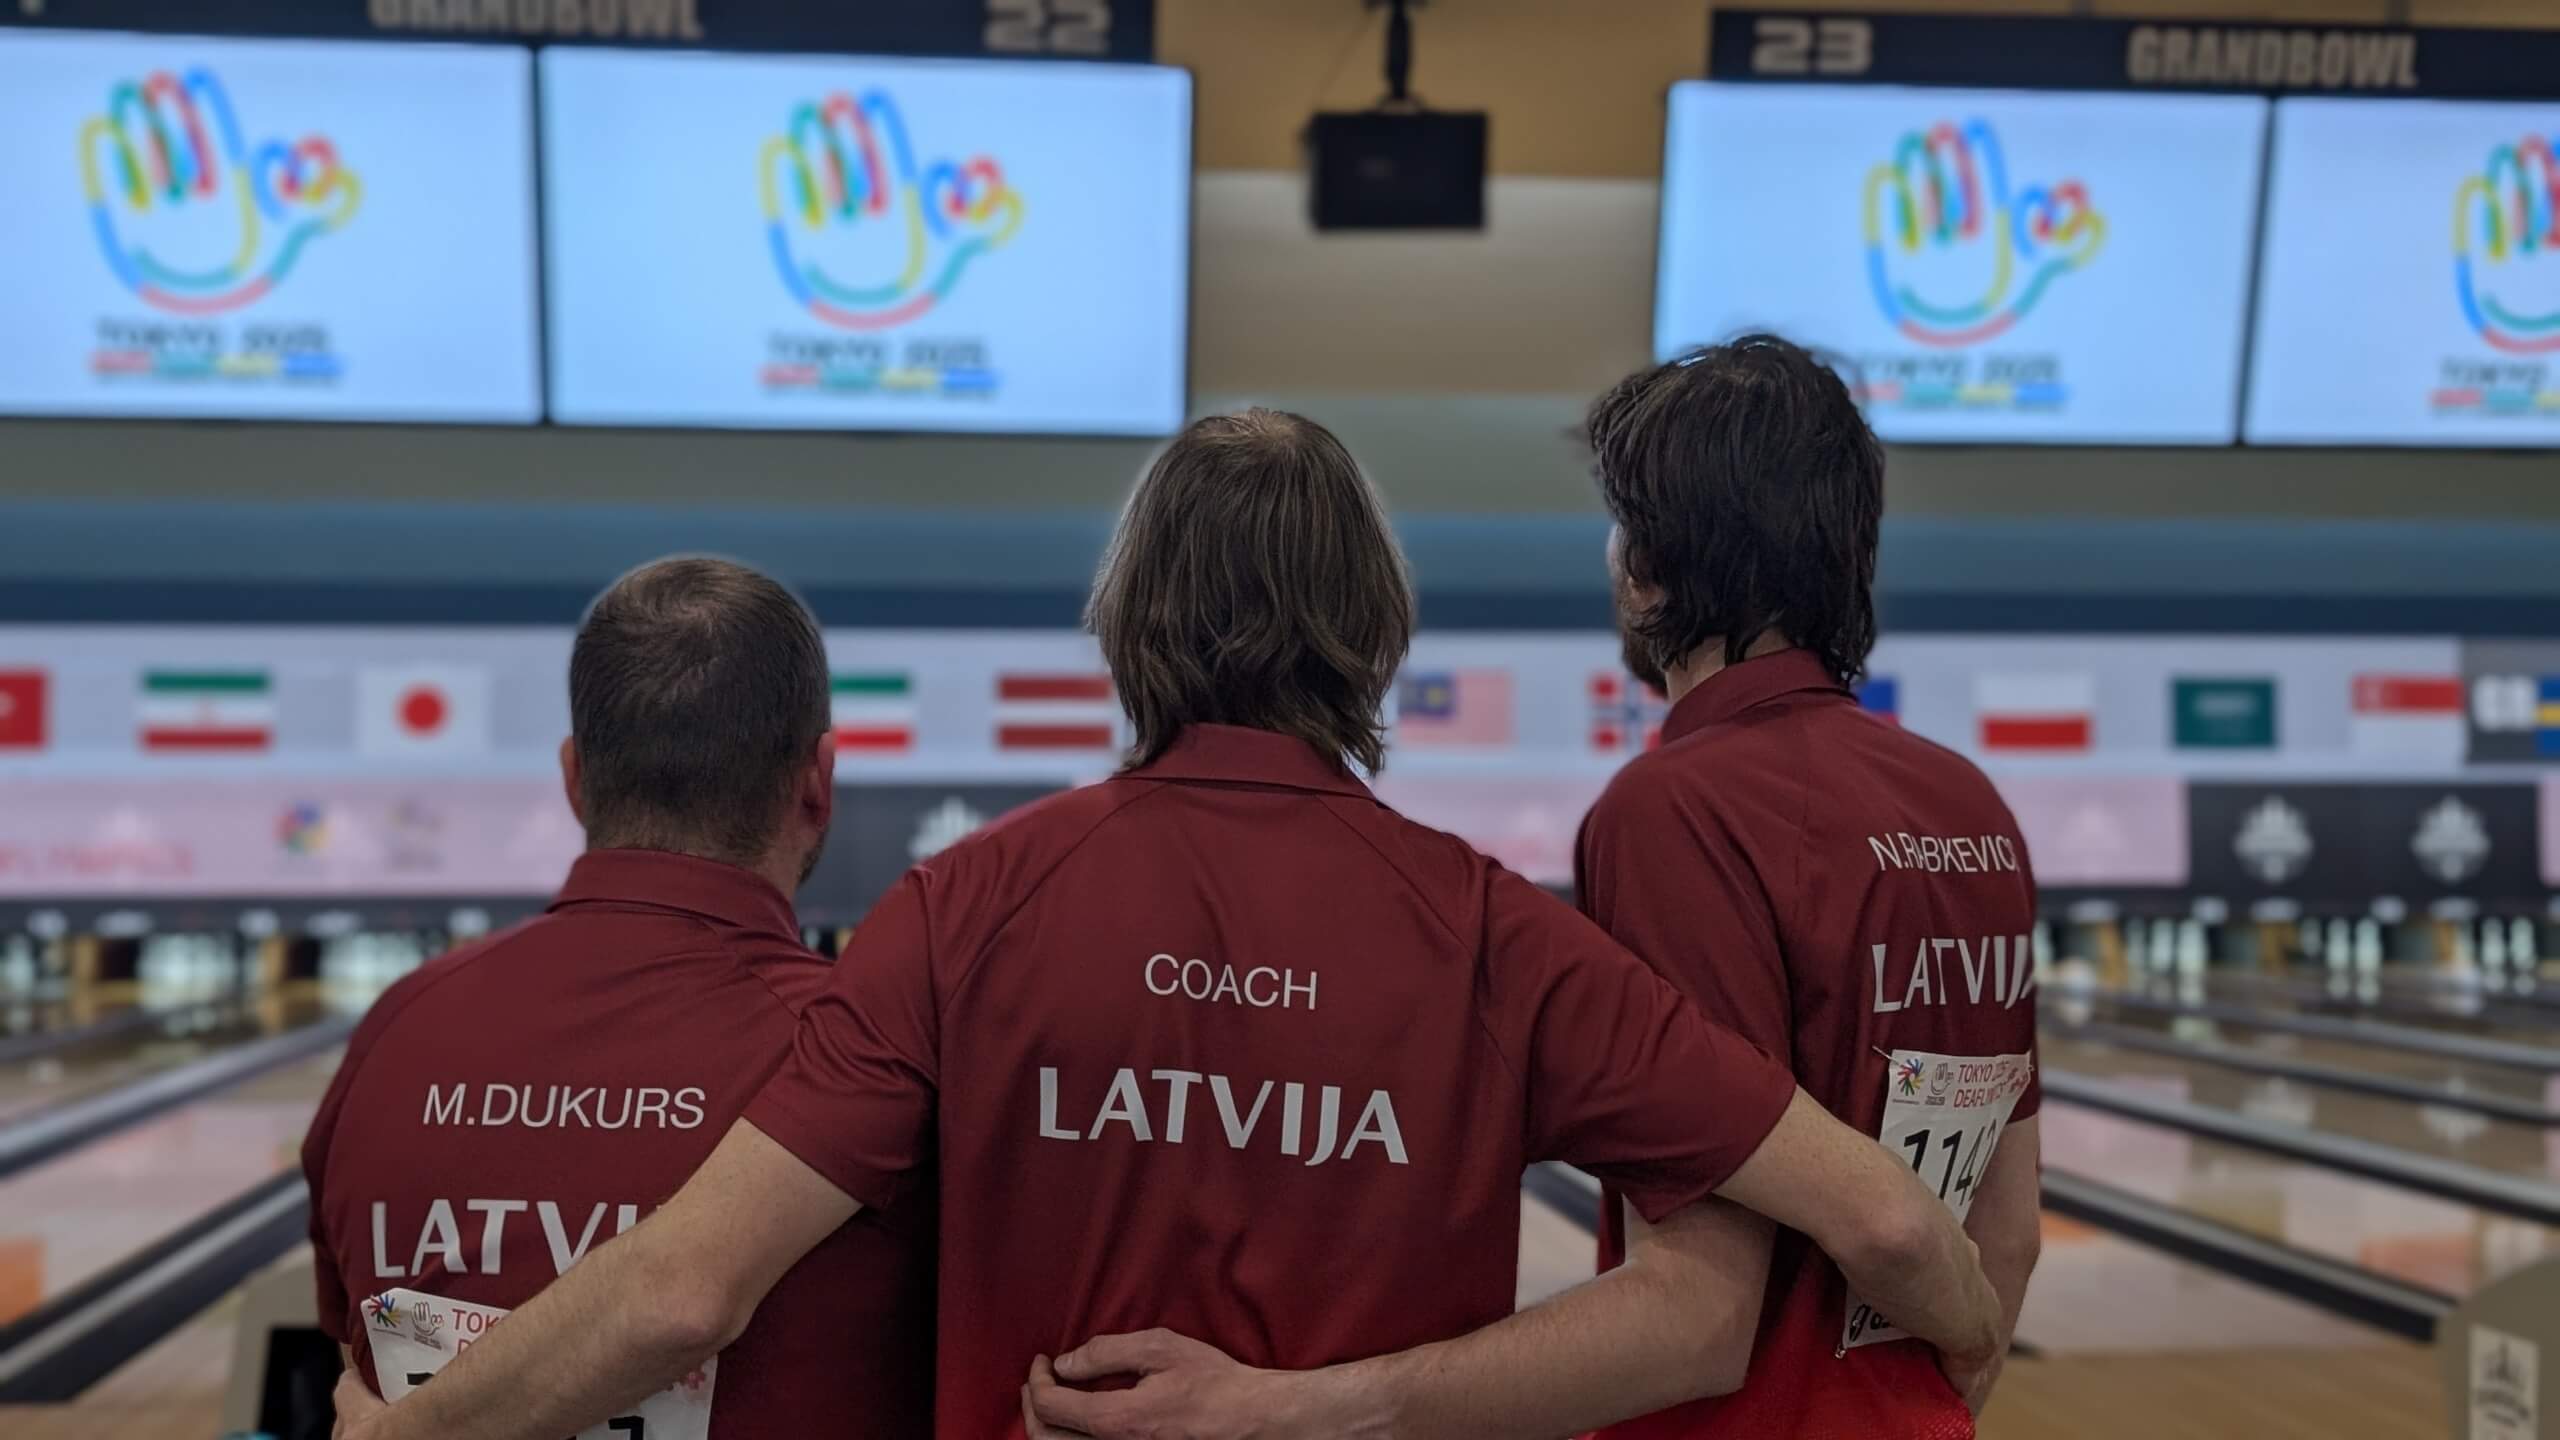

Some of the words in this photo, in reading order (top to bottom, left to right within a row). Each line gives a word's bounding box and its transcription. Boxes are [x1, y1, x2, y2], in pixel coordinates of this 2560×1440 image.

[983, 0, 1111, 52] 22
[1752, 18, 1873, 73] 23
[2127, 25, 2418, 88] GRANDBOWL
[1144, 953, 1318, 1010] COACH
[1871, 935, 2033, 1013] LATVIJ
[1958, 1063, 1993, 1084] TOKYO
[422, 1082, 706, 1129] M.DUKURS
[1039, 1066, 1409, 1166] LATVIJA
